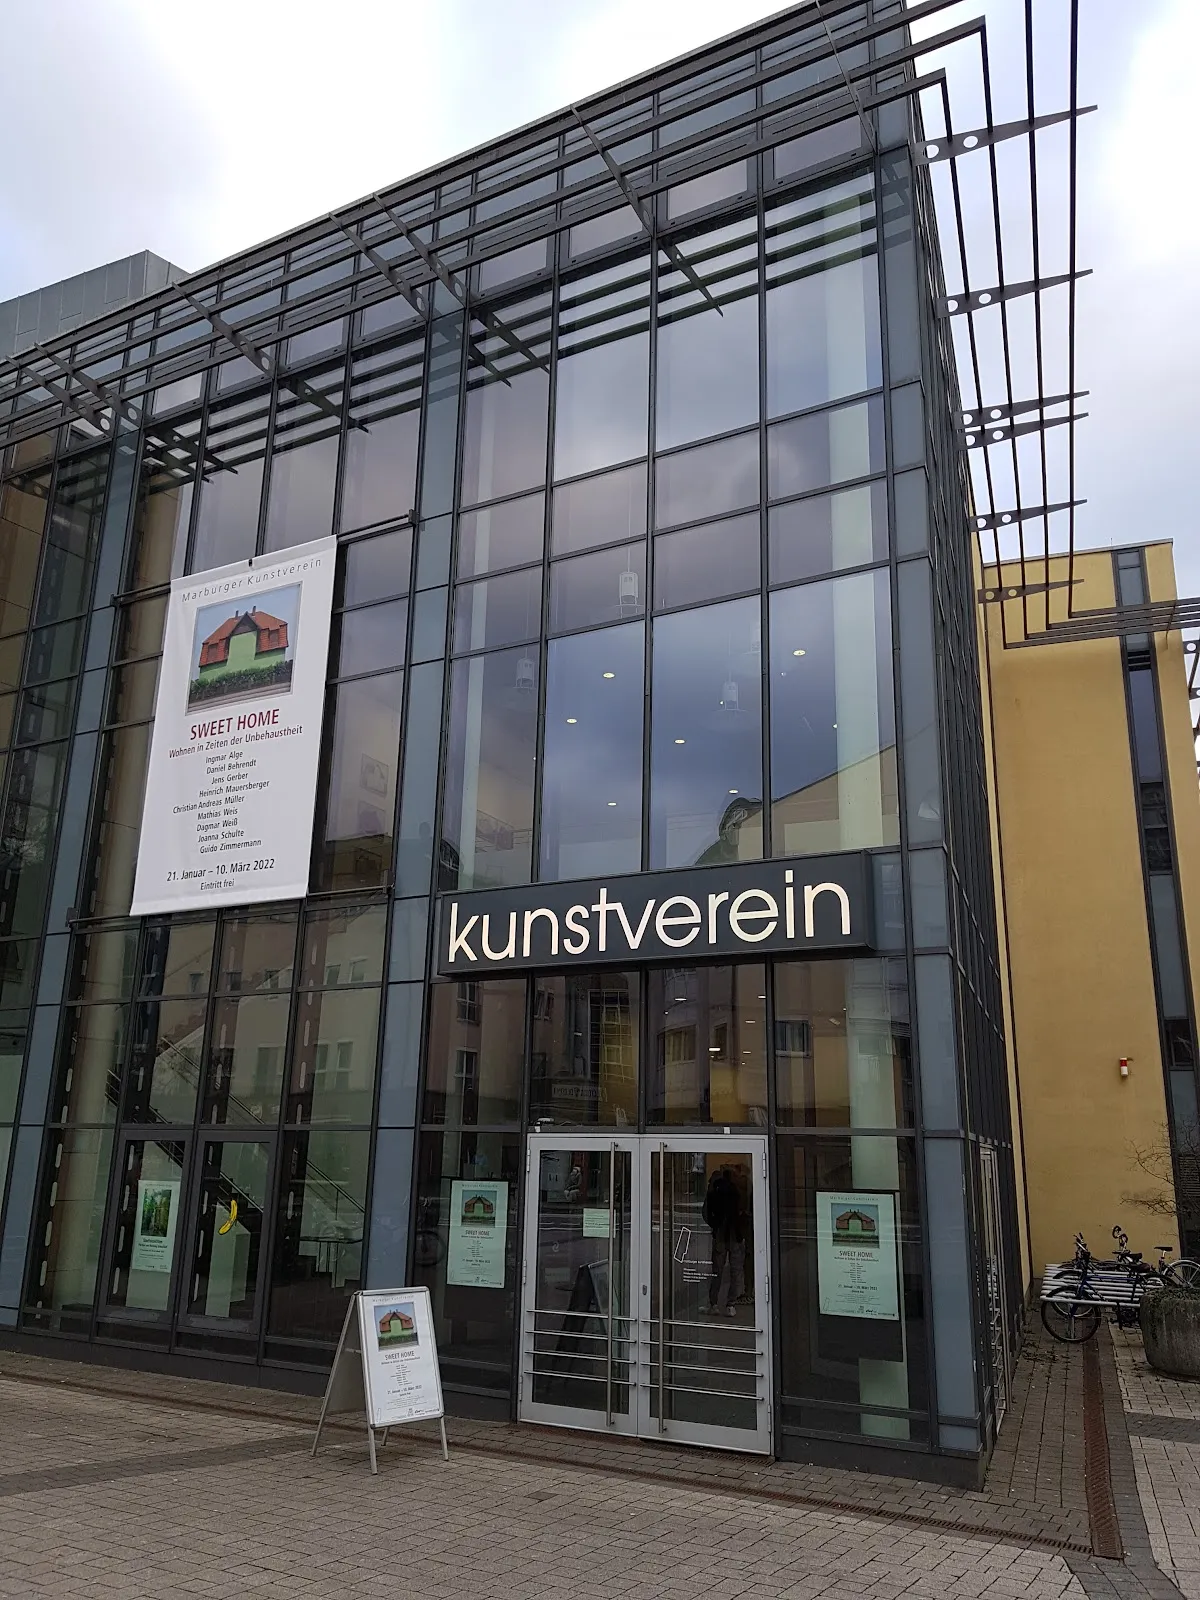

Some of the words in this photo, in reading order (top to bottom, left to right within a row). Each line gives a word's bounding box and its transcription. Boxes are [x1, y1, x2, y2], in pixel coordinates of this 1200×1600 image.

[181, 579, 243, 602] Marburger
[247, 558, 322, 586] Kunstverein
[190, 717, 234, 741] SWEET
[237, 708, 280, 731] HOME
[168, 747, 196, 759] Wohnen
[197, 743, 204, 753] in
[205, 738, 229, 751] Zeiten
[230, 735, 243, 746] der
[245, 725, 303, 743] Unbehaustheit
[205, 753, 227, 764] Ingmar
[228, 751, 244, 761] Alge
[206, 764, 226, 774] Daniel
[228, 759, 257, 771] Behrendt
[211, 776, 225, 785] Jens
[226, 772, 249, 782] Gerber
[199, 786, 224, 798] Heinrich
[225, 780, 270, 794] Mauersberger
[173, 802, 198, 814] Christian
[198, 799, 222, 809] Andreas
[224, 794, 245, 805] Müller
[197, 809, 222, 820] Mathias
[223, 807, 238, 816] Weis
[196, 821, 220, 832] Dagmar
[222, 818, 238, 827] Weiß
[198, 833, 219, 843] Joanna
[221, 829, 245, 840] Schulte
[199, 845, 218, 854] Guido
[219, 838, 262, 851] Zimmermann
[167, 871, 179, 881] 21.
[180, 866, 206, 880] Januar
[215, 864, 228, 875] 10.
[229, 860, 250, 873] März
[253, 858, 275, 870] 2022
[200, 881, 222, 890] Eintritt
[223, 879, 235, 888] frei
[448, 869, 851, 963] kunstverein
[385, 1352, 400, 1361] SWEET
[400, 1350, 415, 1358] HOME
